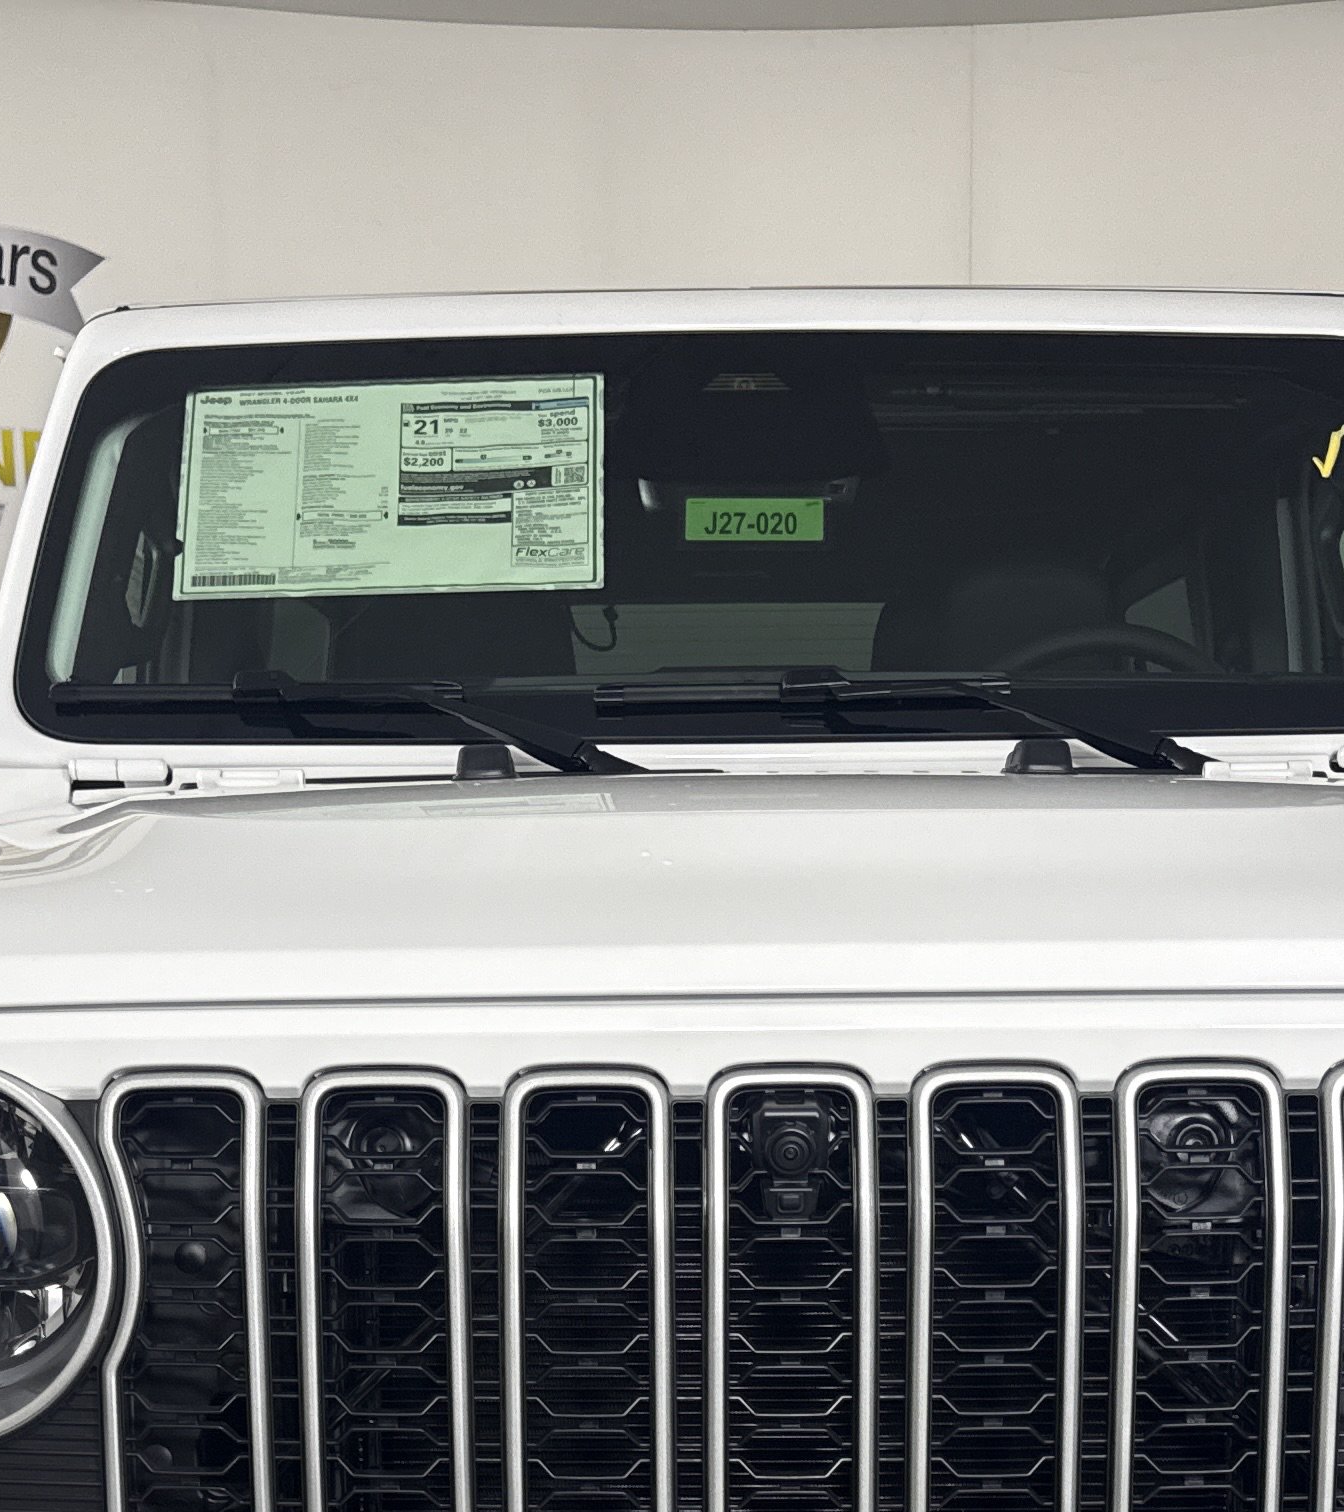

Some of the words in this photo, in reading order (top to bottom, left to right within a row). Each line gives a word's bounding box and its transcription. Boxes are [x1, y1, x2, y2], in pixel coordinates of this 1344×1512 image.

[200, 396, 233, 405] Jeep
[239, 398, 281, 406] WRANGLER
[414, 420, 439, 435] 21
[538, 417, 578, 427] $3,000
[403, 457, 444, 468] $2,200
[704, 512, 798, 535] J27-020
[516, 546, 585, 557] FlexCare
